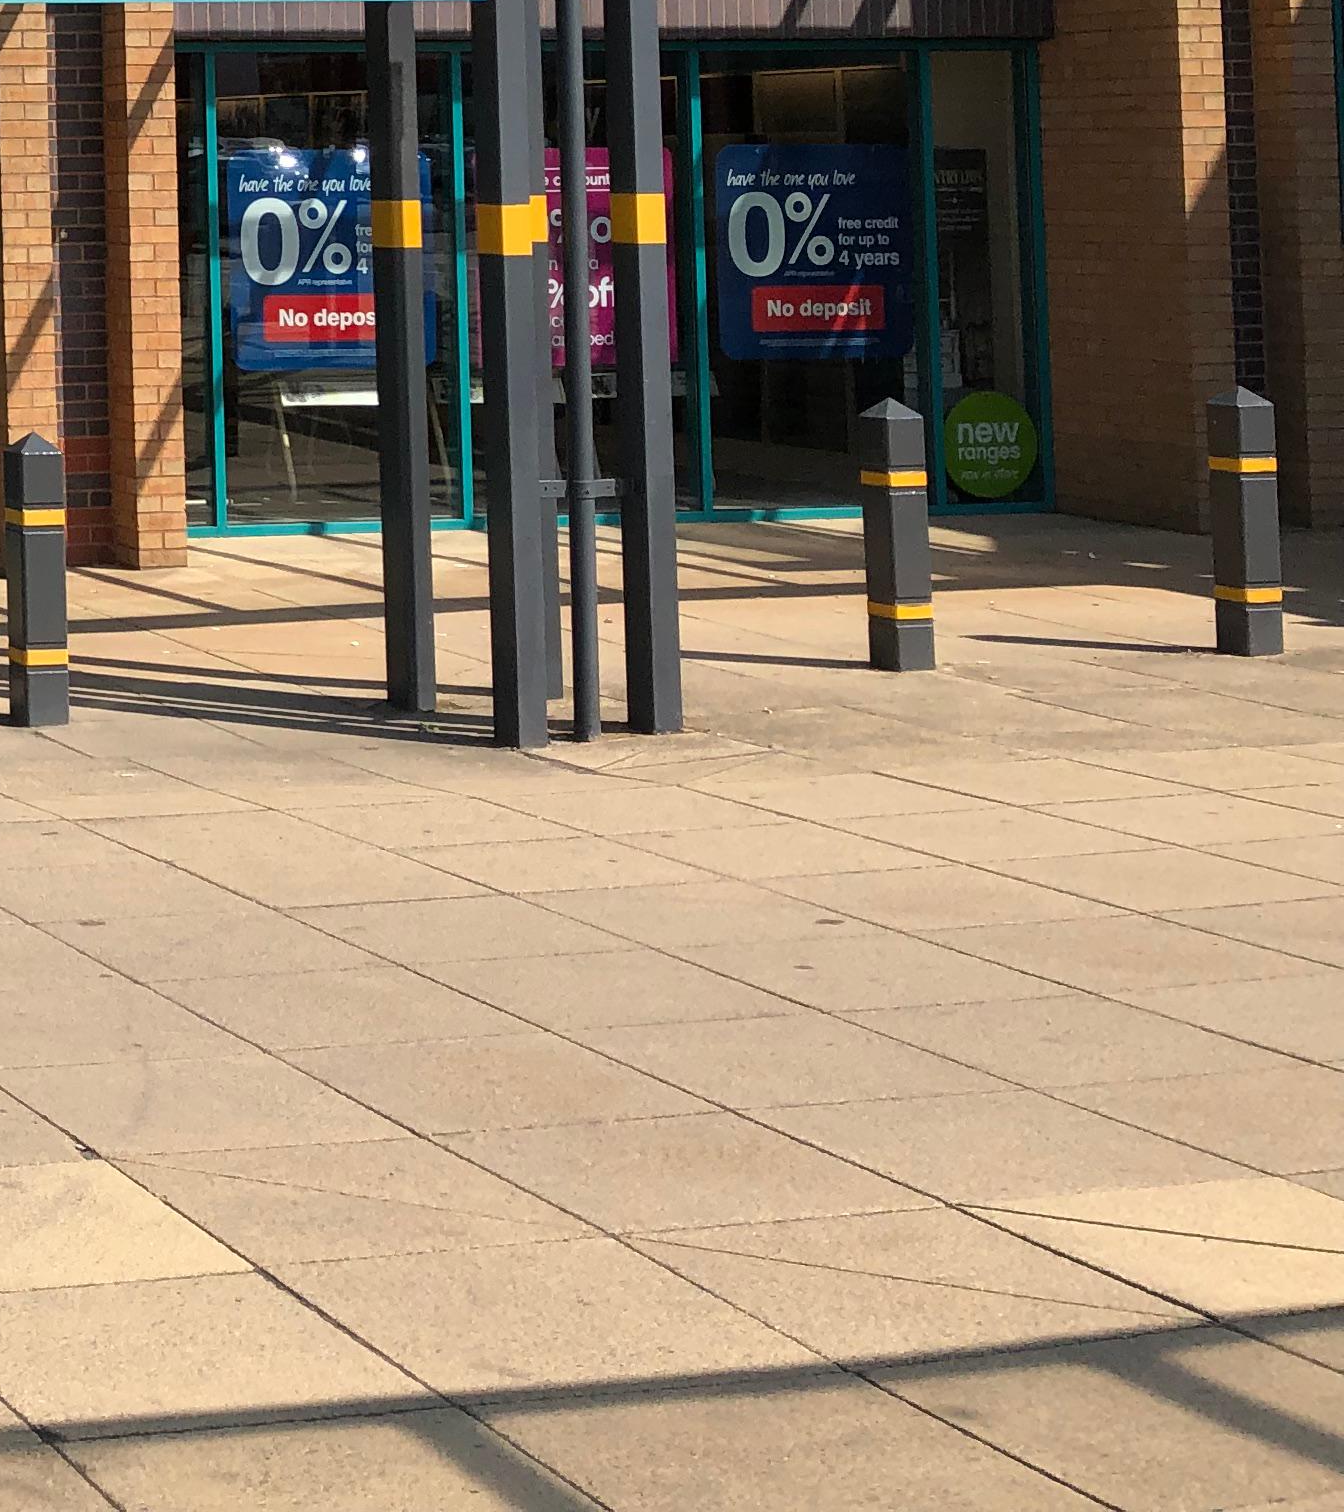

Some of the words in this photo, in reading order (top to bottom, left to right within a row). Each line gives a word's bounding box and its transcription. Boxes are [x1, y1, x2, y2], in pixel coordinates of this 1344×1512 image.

[239, 174, 269, 192] have
[273, 174, 293, 192] the
[297, 178, 318, 191] one
[322, 179, 345, 196] you
[727, 169, 755, 187] have
[760, 169, 780, 187] the
[784, 174, 805, 186] one
[808, 175, 828, 190] you
[833, 170, 856, 186] love
[355, 224, 372, 237] fre
[838, 217, 861, 229] free
[865, 217, 899, 229] credit
[240, 197, 352, 286] 0%
[728, 191, 834, 277] 0%
[838, 233, 854, 245] for
[859, 235, 874, 247] up
[878, 233, 889, 245] to
[356, 258, 368, 274] 4
[839, 251, 850, 265] 4
[855, 251, 900, 269] years
[279, 309, 308, 327] No
[314, 308, 376, 331] depos
[767, 299, 794, 317] No
[800, 298, 871, 320] deposit
[957, 422, 1019, 444] new
[958, 445, 1021, 465] ranges
